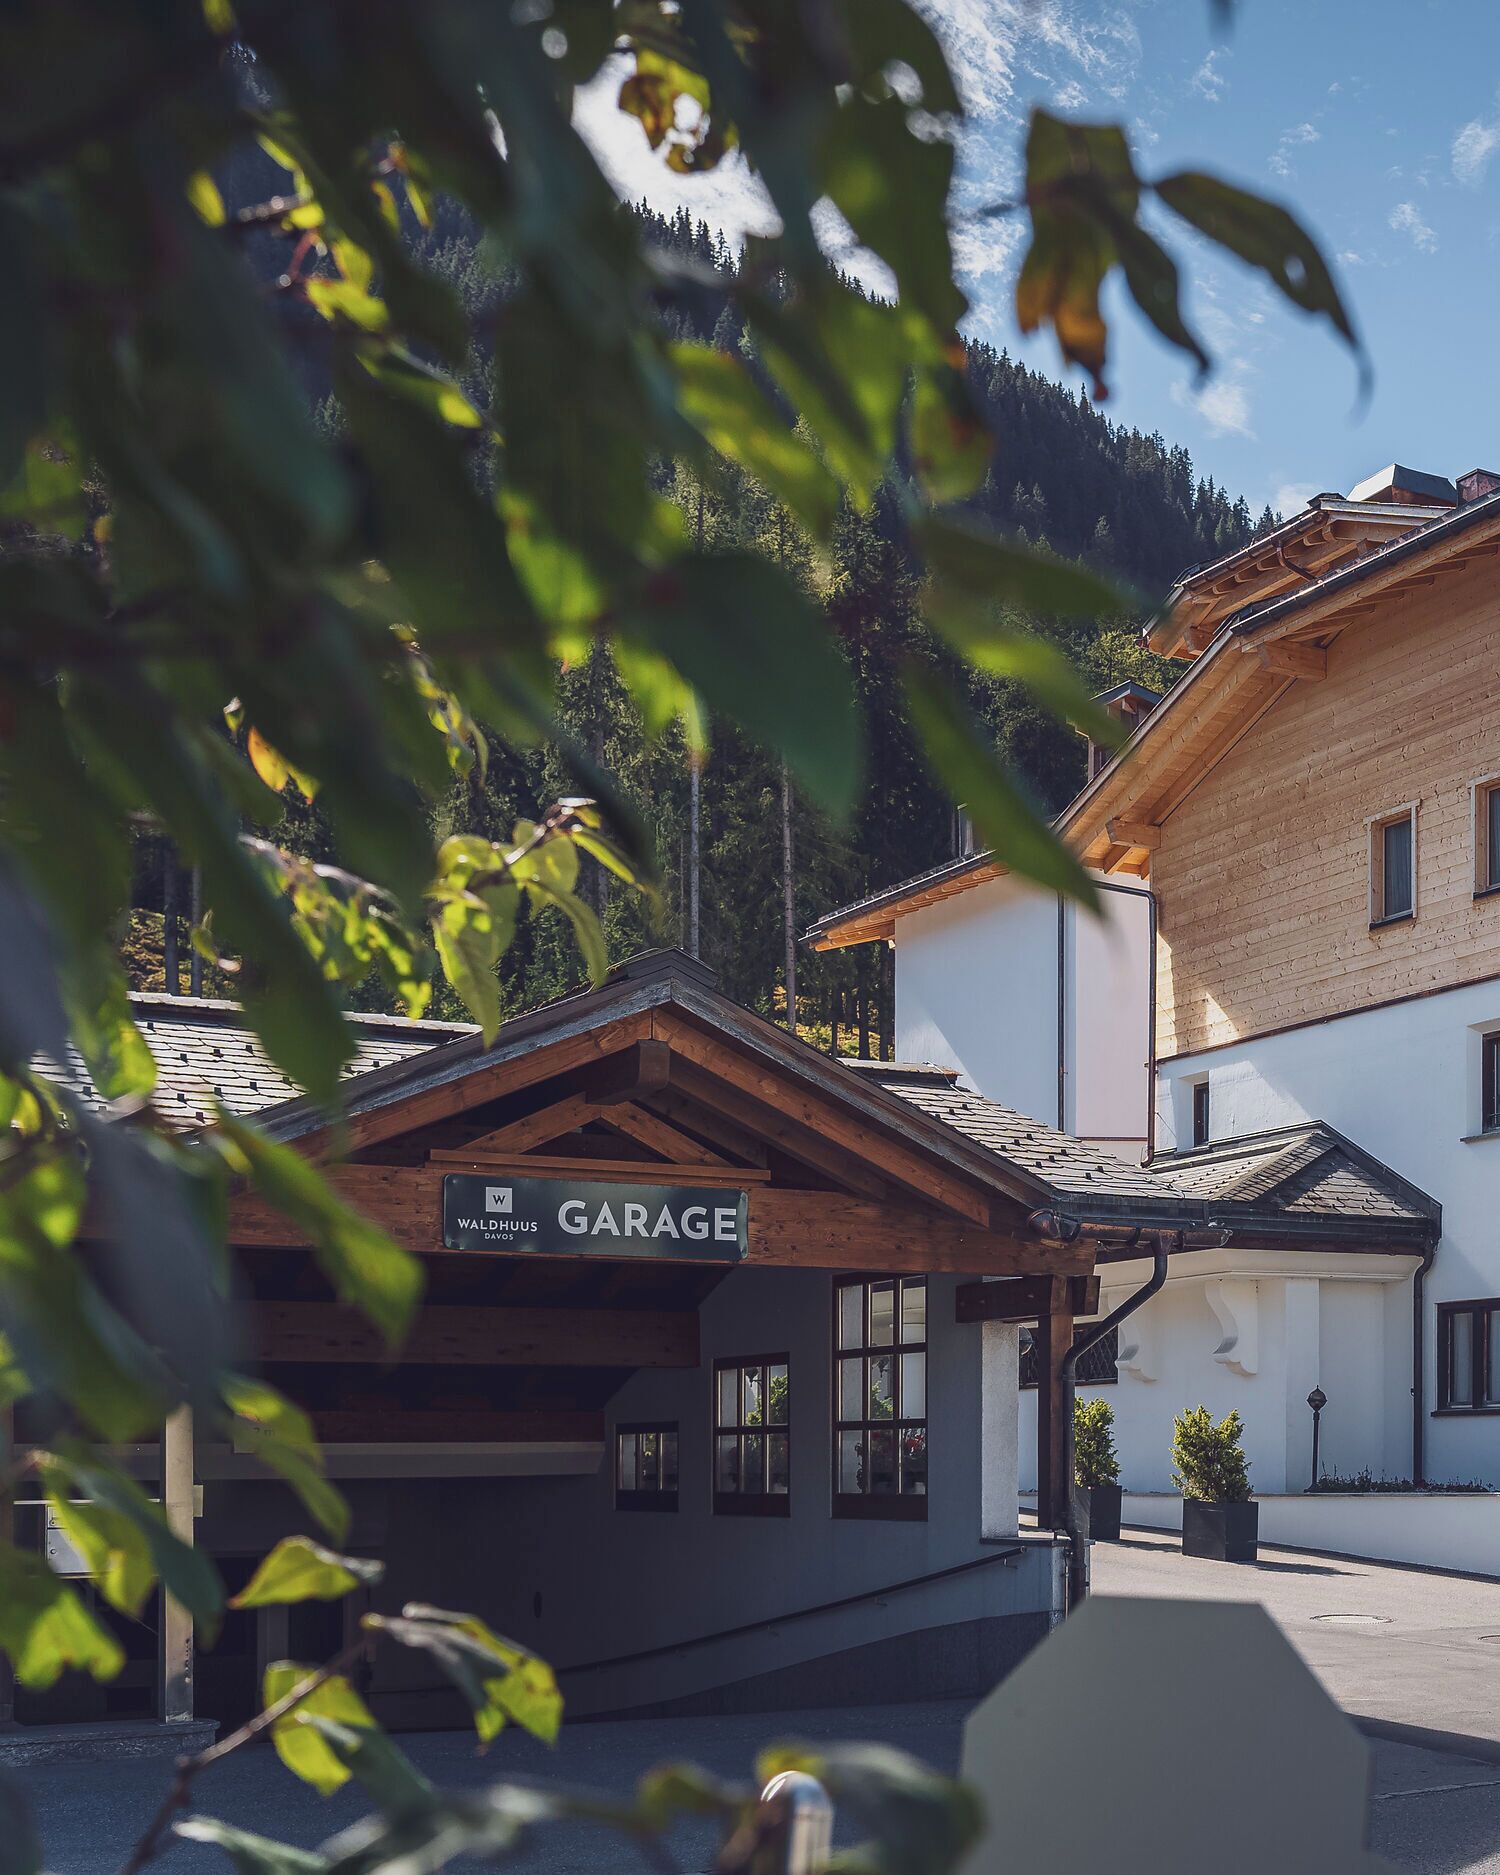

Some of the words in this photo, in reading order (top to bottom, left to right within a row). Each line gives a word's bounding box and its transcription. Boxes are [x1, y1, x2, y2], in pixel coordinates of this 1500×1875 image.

[492, 1194, 506, 1206] W
[457, 1218, 538, 1232] WALDHUUS
[557, 1199, 737, 1241] GARAGE
[484, 1232, 514, 1241] DAVOS
